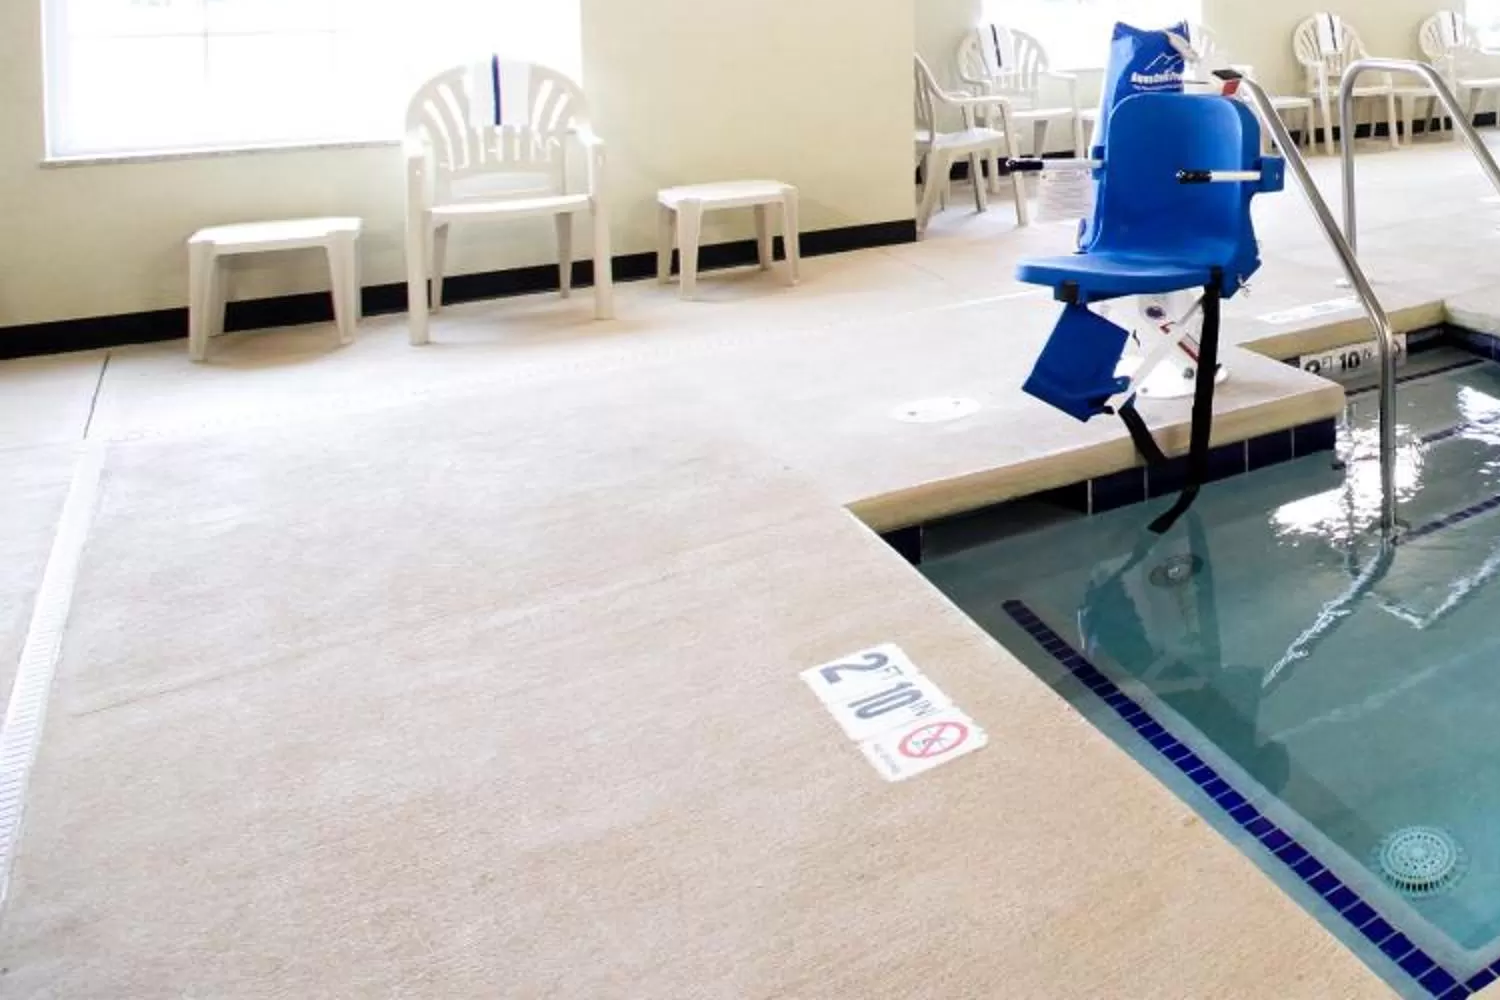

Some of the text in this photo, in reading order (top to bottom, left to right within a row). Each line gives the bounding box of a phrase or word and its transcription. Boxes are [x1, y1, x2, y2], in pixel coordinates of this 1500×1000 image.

[1339, 350, 1361, 372] 10
[819, 652, 889, 685] 2
[848, 681, 924, 720] 10
